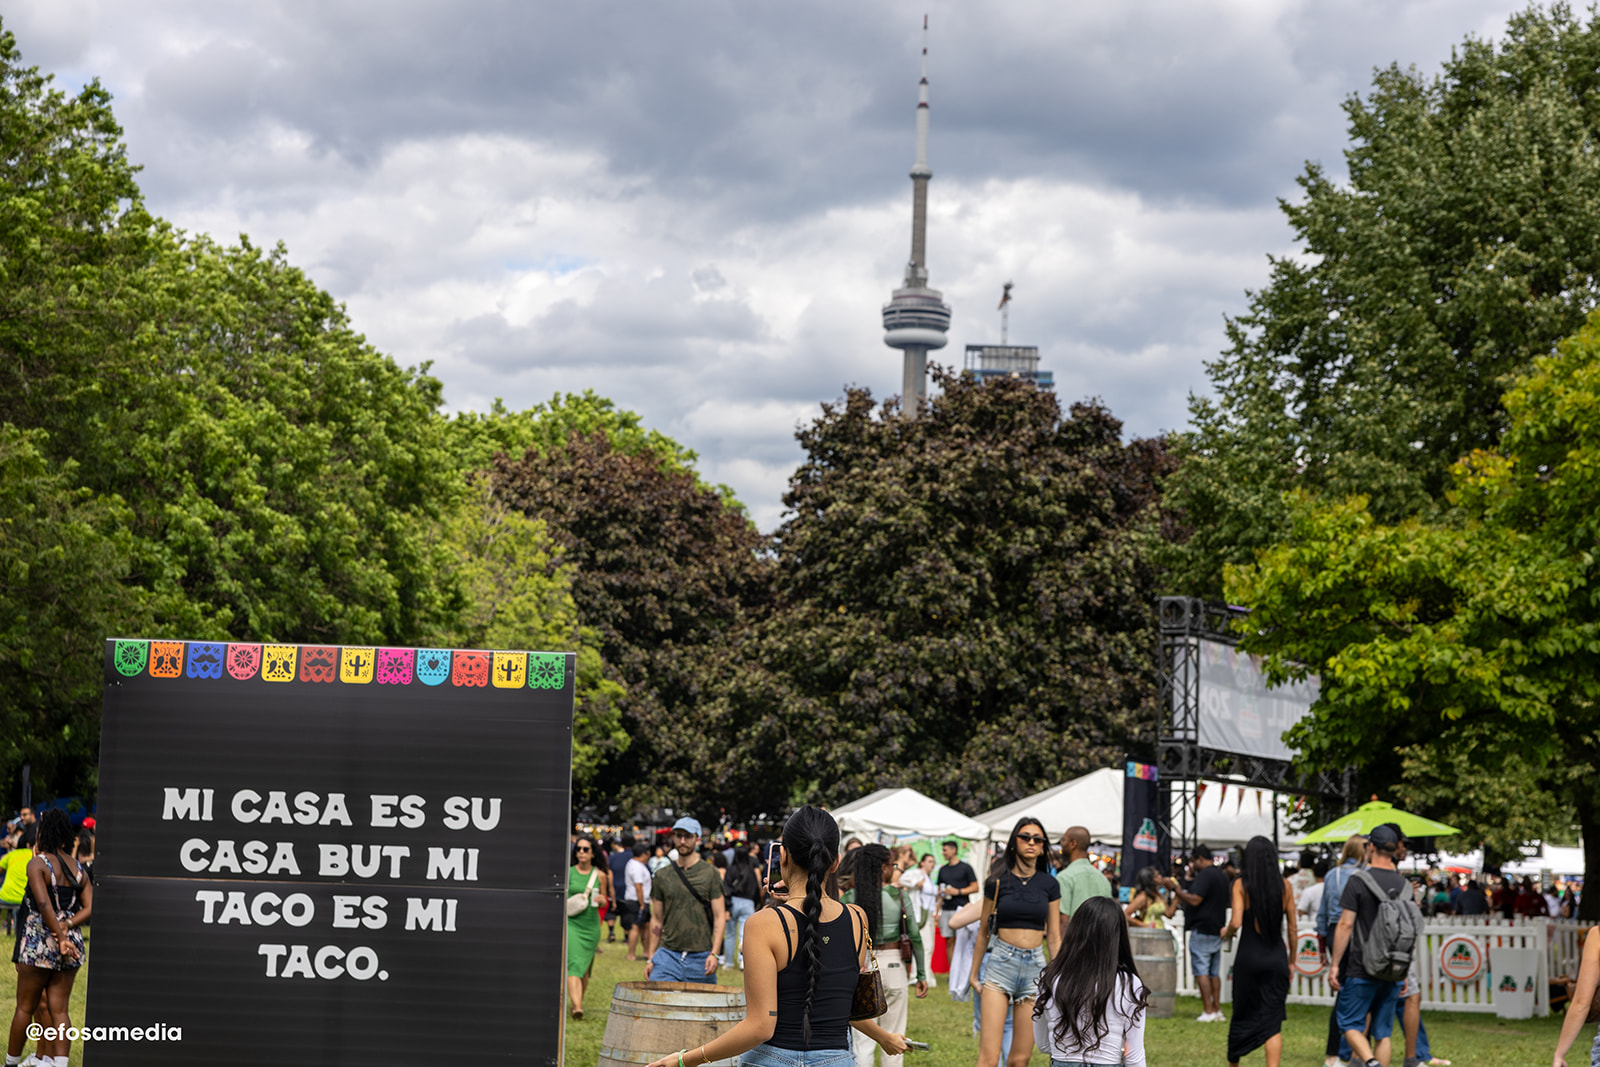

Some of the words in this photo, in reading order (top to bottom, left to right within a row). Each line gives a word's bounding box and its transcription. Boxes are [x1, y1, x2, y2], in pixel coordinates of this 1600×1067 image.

[162, 787, 215, 822] MI
[231, 789, 353, 827] CASA
[369, 794, 426, 829] ES
[442, 796, 502, 831] SU
[179, 838, 302, 876] CASA
[318, 843, 411, 879] BUT
[425, 847, 480, 881] MI
[195, 890, 315, 927] TACO
[332, 895, 389, 930] ES
[404, 897, 458, 932] MI
[257, 943, 390, 981] TACO.
